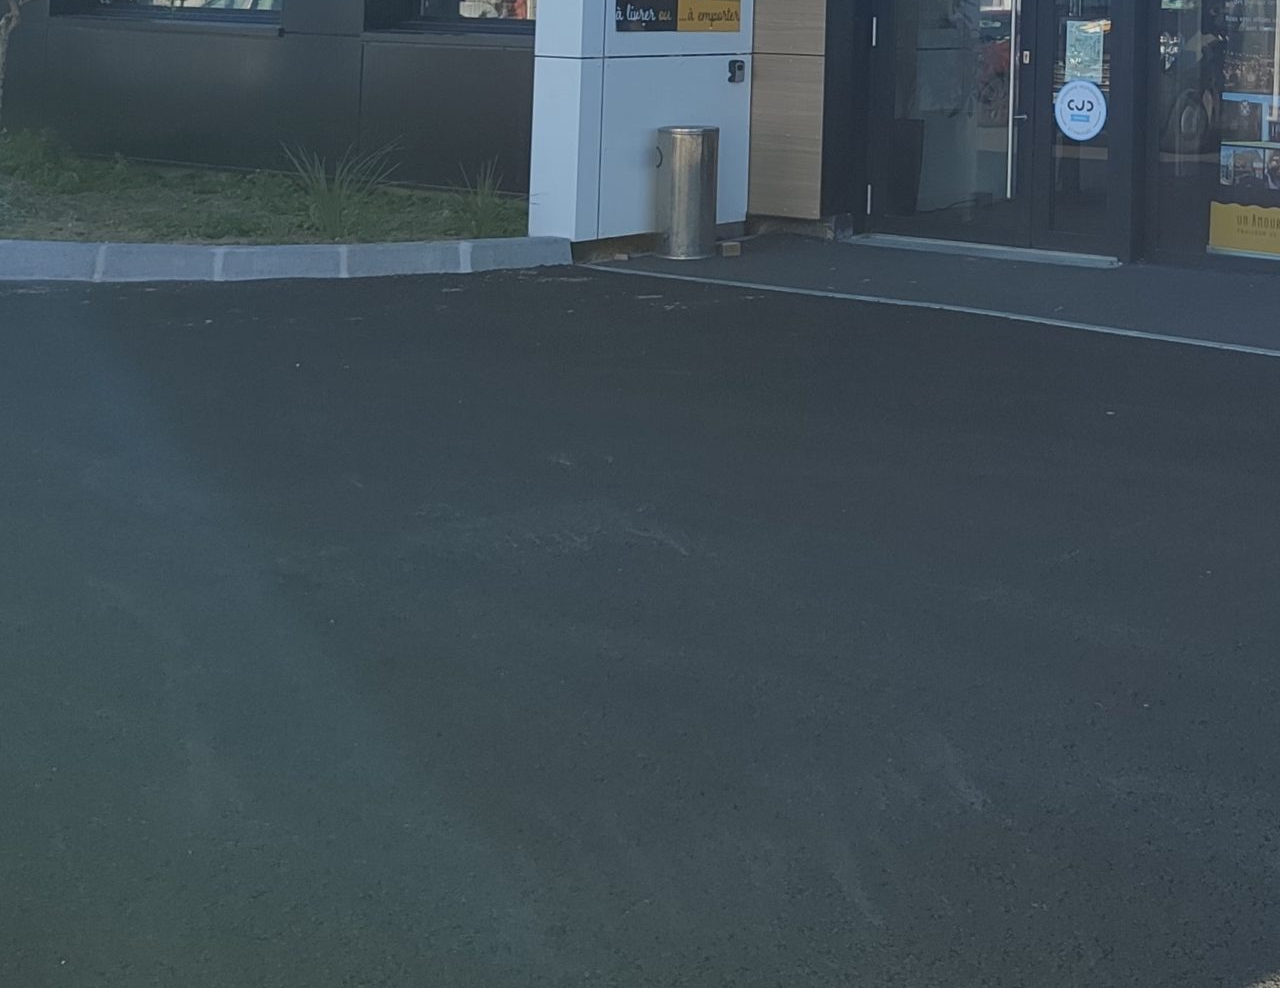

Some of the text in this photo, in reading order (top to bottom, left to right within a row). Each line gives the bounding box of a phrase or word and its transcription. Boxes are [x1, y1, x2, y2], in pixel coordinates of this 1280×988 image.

[616, 3, 672, 21] à livrer ou
[696, 8, 740, 27] emporter
[1252, 214, 1280, 230] AMOUR
